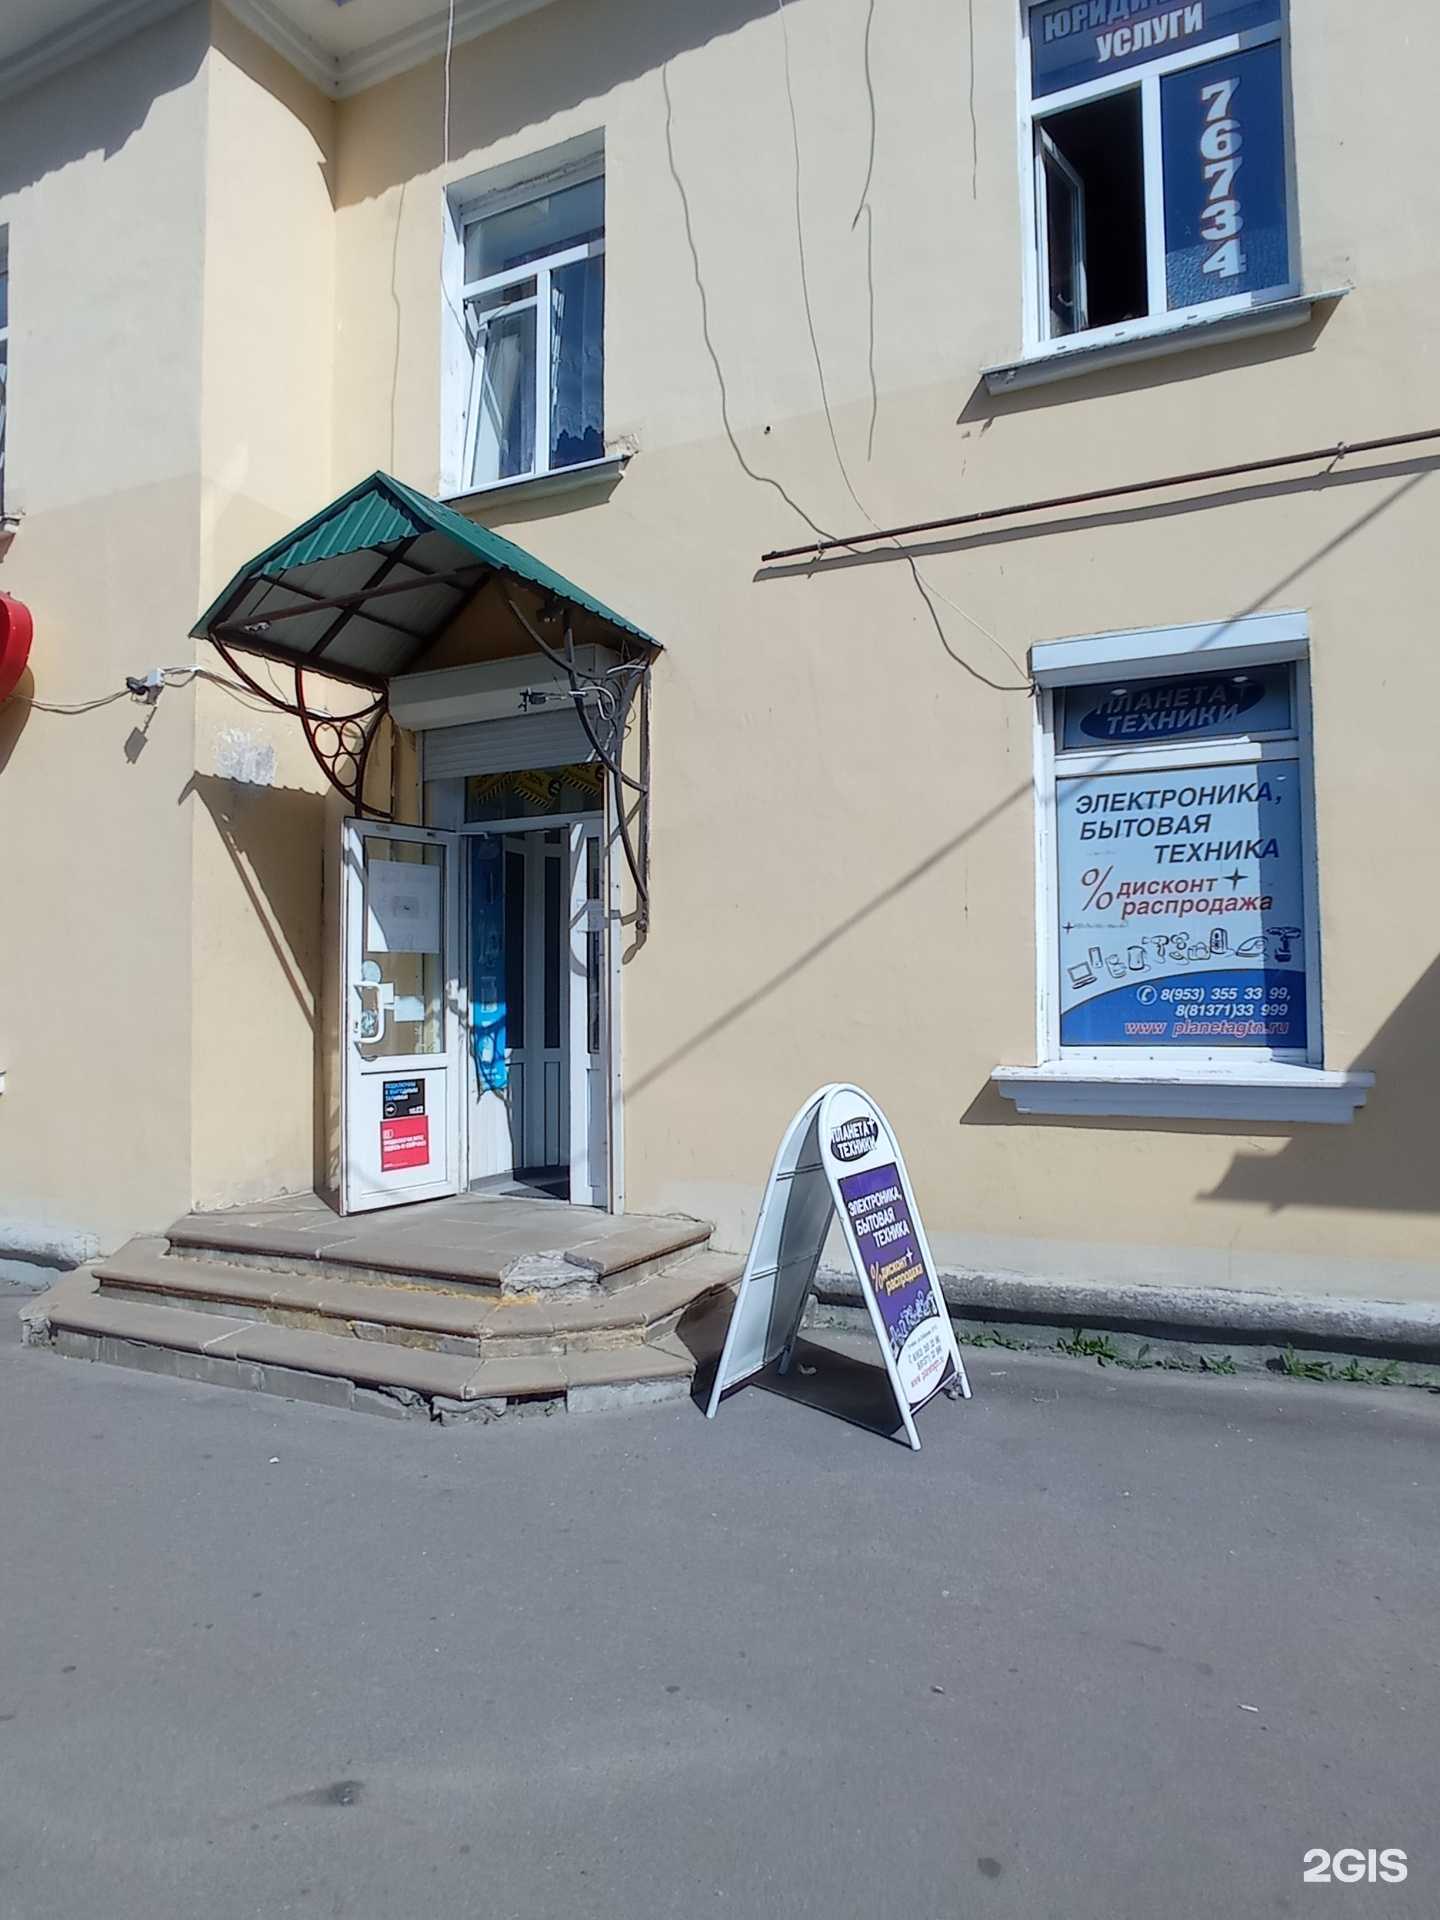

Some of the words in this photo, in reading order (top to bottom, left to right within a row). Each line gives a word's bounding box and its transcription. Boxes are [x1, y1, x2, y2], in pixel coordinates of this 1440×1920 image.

[1045, 0, 1163, 42] ЮРИД
[1096, 3, 1203, 62] УСЛУГИ
[1097, 683, 1227, 715] ПЛАНЕТА
[1107, 703, 1239, 735] ТЕХНИКИ
[1075, 782, 1282, 814] ЭЛЕКТРОНИКА,
[1080, 813, 1212, 841] БЫТОВАЯ
[1154, 838, 1280, 864] ТЕХНИКА
[1116, 878, 1218, 899] дисконт
[1121, 895, 1273, 920] распродажа
[1160, 987, 1205, 1003] 8(953)
[1211, 987, 1238, 1000] 355
[1244, 987, 1263, 1000] 33
[1261, 1004, 1288, 1016] 999
[1125, 1022, 1168, 1035] www
[831, 1120, 870, 1144] ПЛАНЕТА
[855, 1206, 896, 1236] БЫТОВАЯ
[872, 1220, 910, 1248] ТЕХНИКА
